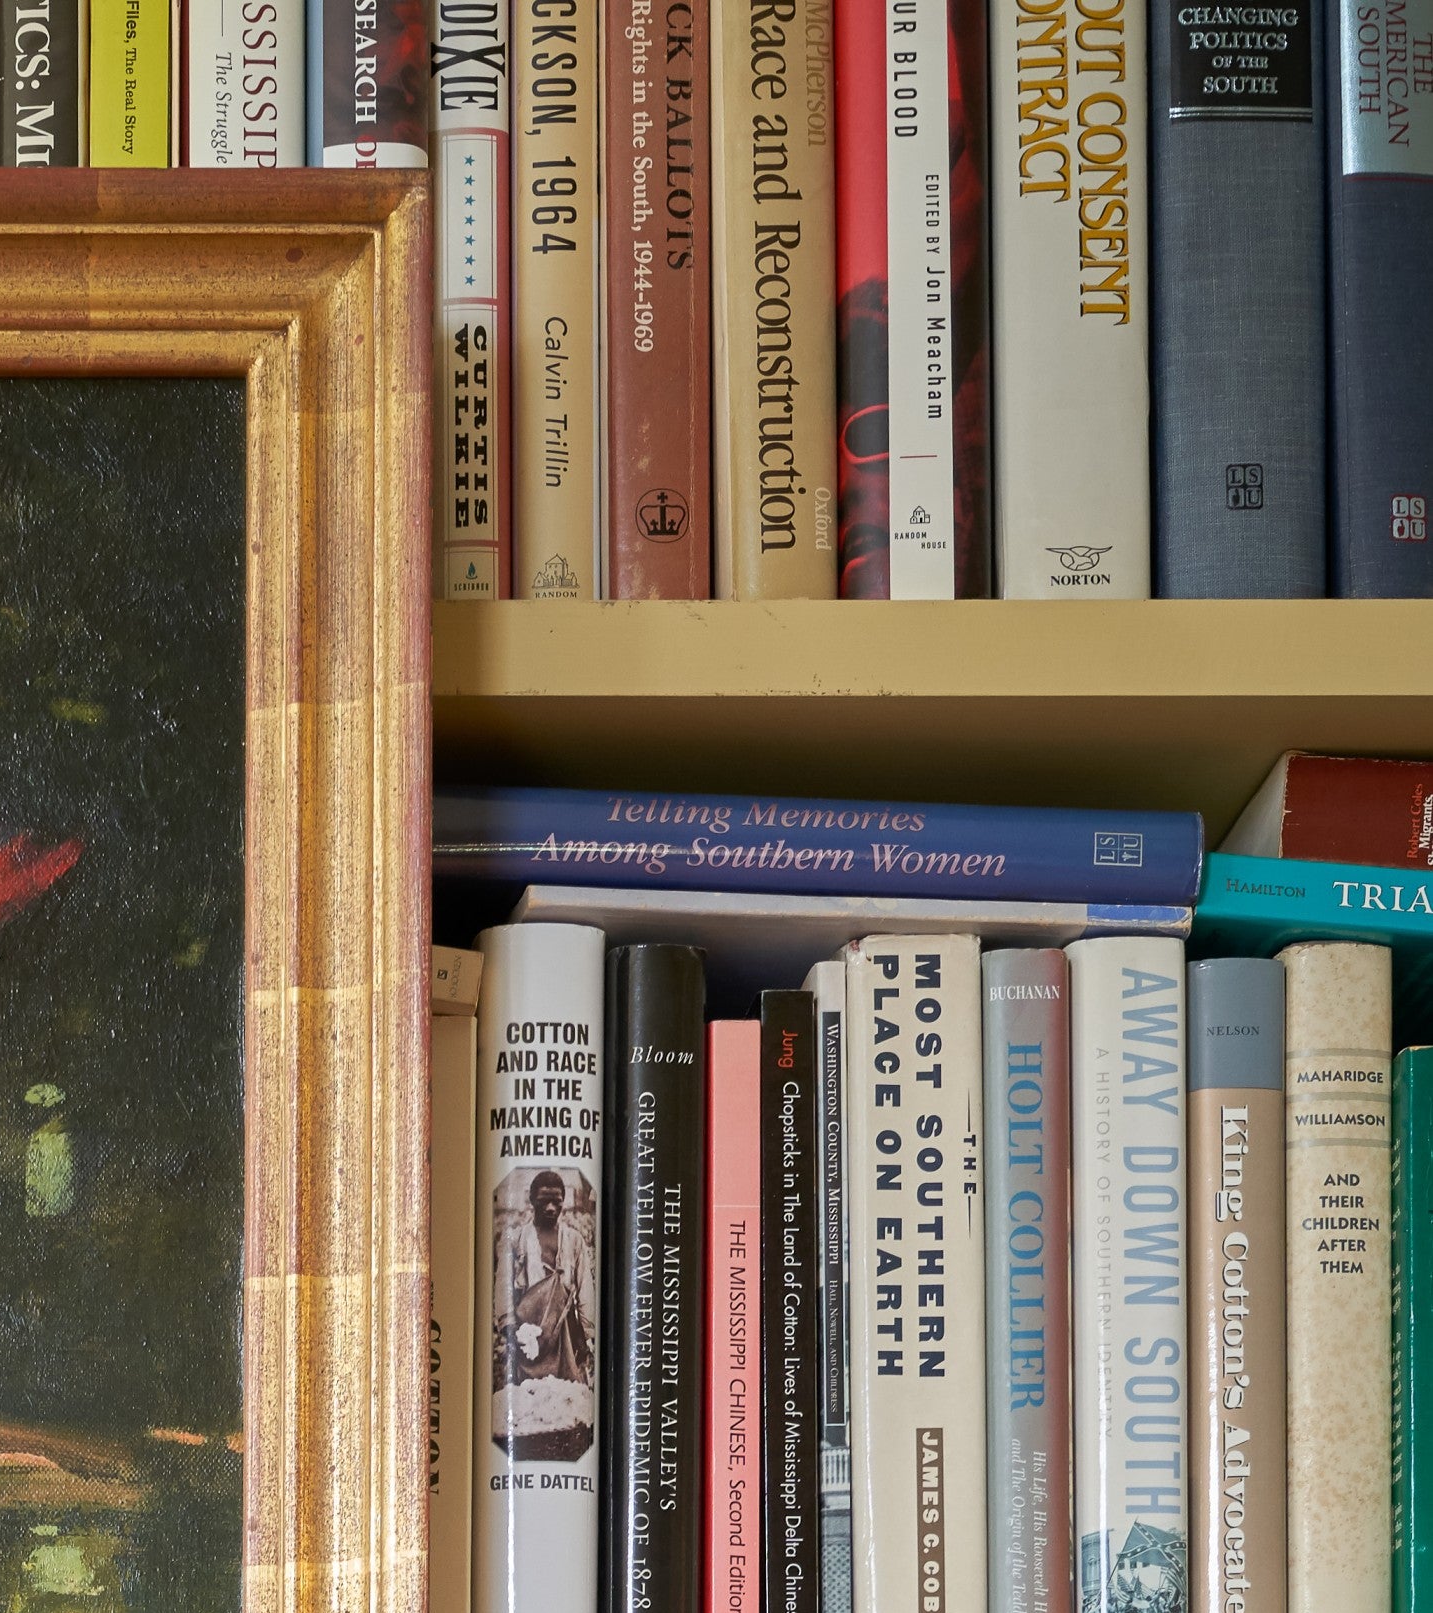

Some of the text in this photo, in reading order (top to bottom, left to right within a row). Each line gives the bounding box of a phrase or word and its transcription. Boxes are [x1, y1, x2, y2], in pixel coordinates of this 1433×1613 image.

[1179, 8, 1298, 29] CHANGING
[1189, 31, 1287, 52] POLITICS
[1203, 76, 1277, 96] SOUTH
[544, 316, 567, 490] Calvin Trillin
[1049, 572, 1111, 586] NORTON
[608, 798, 926, 832] Telling Memories
[533, 835, 1005, 878] Among Southern Women
[990, 985, 1061, 1001] BUCHANAN
[506, 1023, 589, 1045] COTTON
[495, 1050, 597, 1074] AND RACE
[1297, 1070, 1384, 1084] MAHARIDGE
[513, 1079, 582, 1100] IN THE
[490, 1107, 601, 1131] MAKING OF
[1295, 1113, 1385, 1126] WILLIAMSON
[499, 1134, 593, 1158] AMERICA
[490, 1473, 594, 1493] GENE DATTEL
